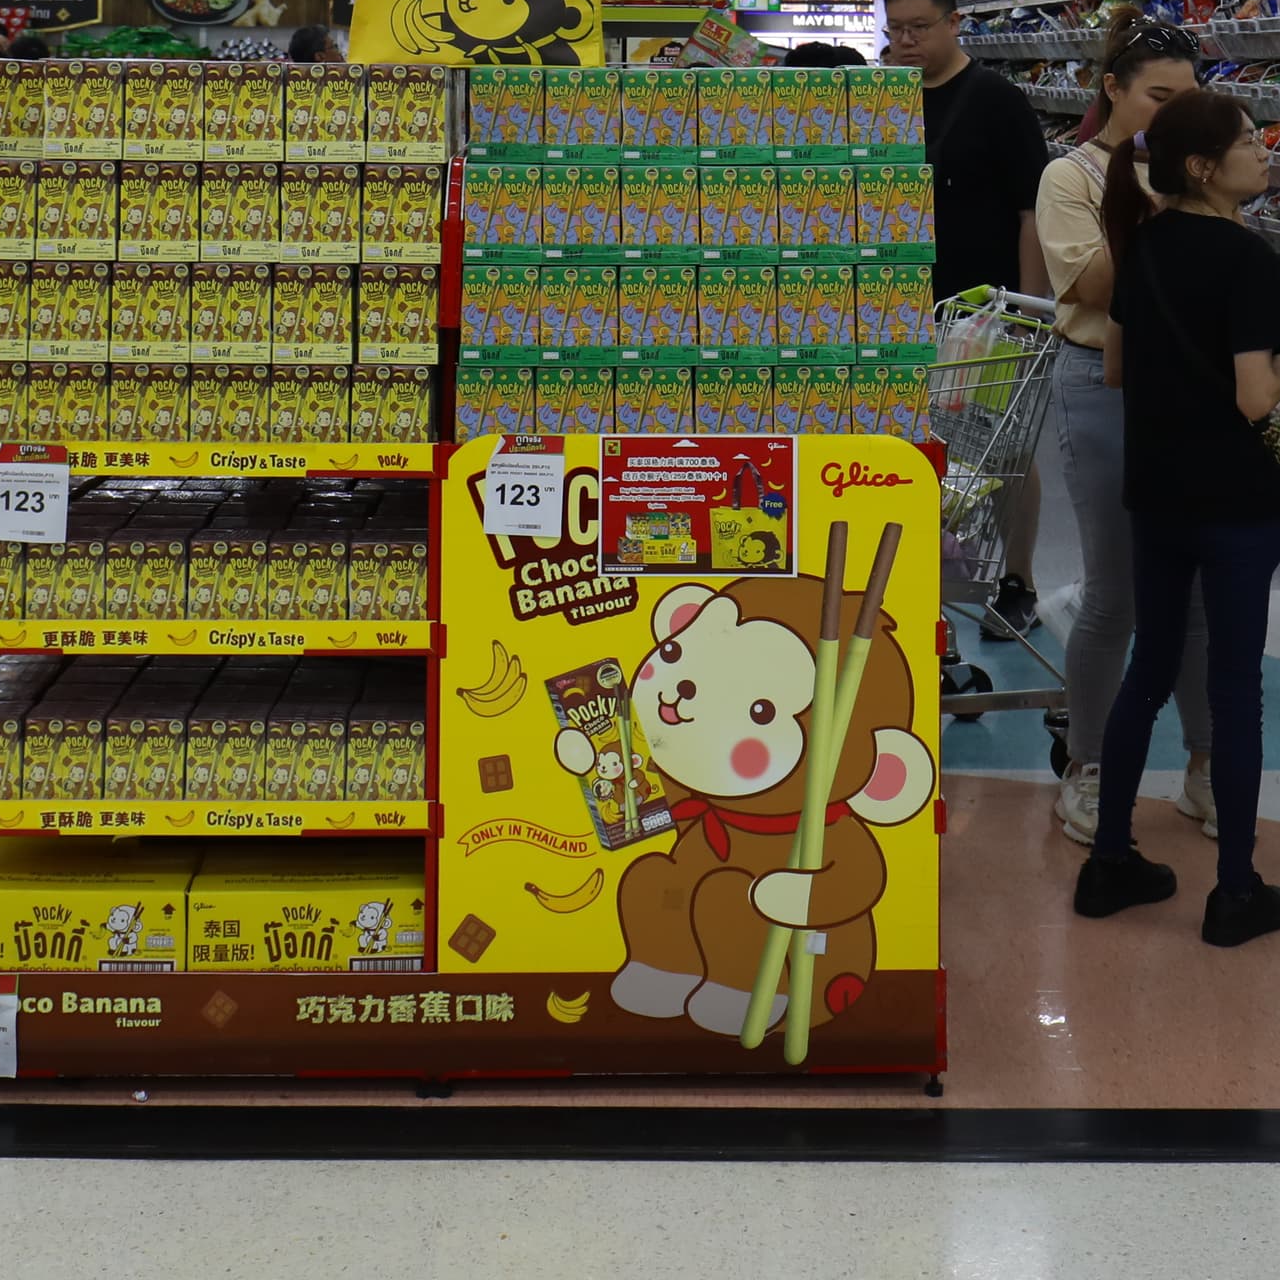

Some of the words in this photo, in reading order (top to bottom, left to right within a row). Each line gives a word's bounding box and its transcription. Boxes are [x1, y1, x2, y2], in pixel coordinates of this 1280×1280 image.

[104, 452, 150, 467] 更美味
[210, 449, 257, 470] Crispy
[259, 456, 268, 469] &
[269, 452, 306, 469] Taste
[0, 490, 45, 513] 123
[495, 483, 541, 507] 123
[764, 500, 784, 508] Free
[517, 576, 631, 615] Banana
[570, 594, 633, 620] flavour
[42, 630, 96, 648] 更酥脆
[102, 630, 149, 645] 更美味
[208, 628, 255, 649] Crispy
[257, 635, 265, 647] &
[267, 631, 305, 647] Taste
[39, 810, 93, 829] 更酥脆
[99, 810, 146, 827] 更美味
[206, 809, 254, 830] Crispy
[255, 817, 264, 828] &
[265, 812, 303, 828] Taste
[471, 823, 506, 845] ONLY
[507, 824, 522, 840] IN
[525, 825, 588, 854] THAILAND
[203, 919, 241, 938] 泰国
[192, 943, 255, 963] 限量版!
[62, 991, 162, 1015] Banana
[296, 990, 515, 1025] 巧克力香蕉口味
[115, 1017, 162, 1028] flavour
